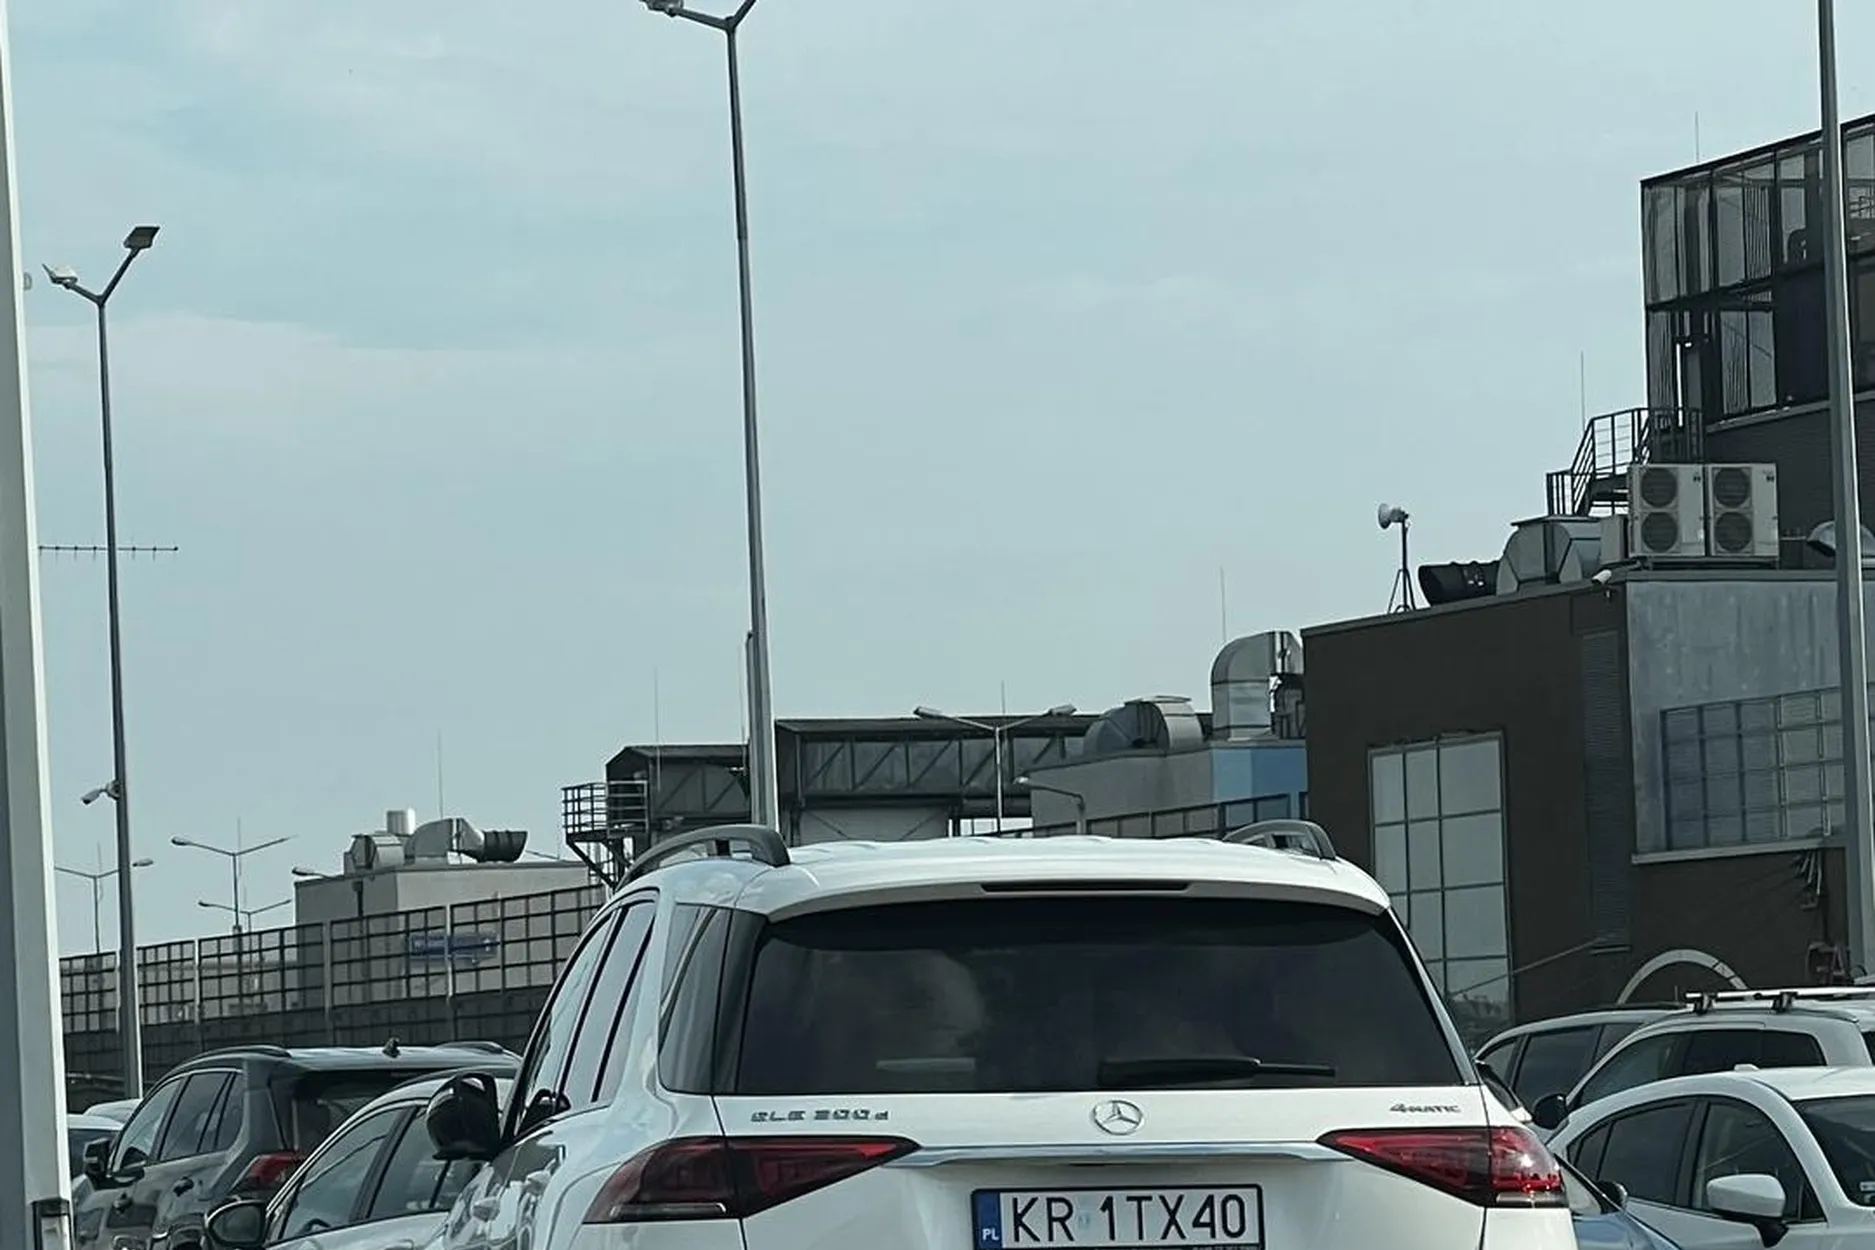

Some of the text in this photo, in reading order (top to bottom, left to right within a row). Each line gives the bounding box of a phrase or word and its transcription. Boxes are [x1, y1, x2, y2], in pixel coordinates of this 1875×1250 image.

[1390, 1103, 1462, 1113] 4MATIC
[750, 1110, 806, 1122] GLE
[1011, 1193, 1247, 1242] KR 1TX40
[982, 1228, 1000, 1240] PL
